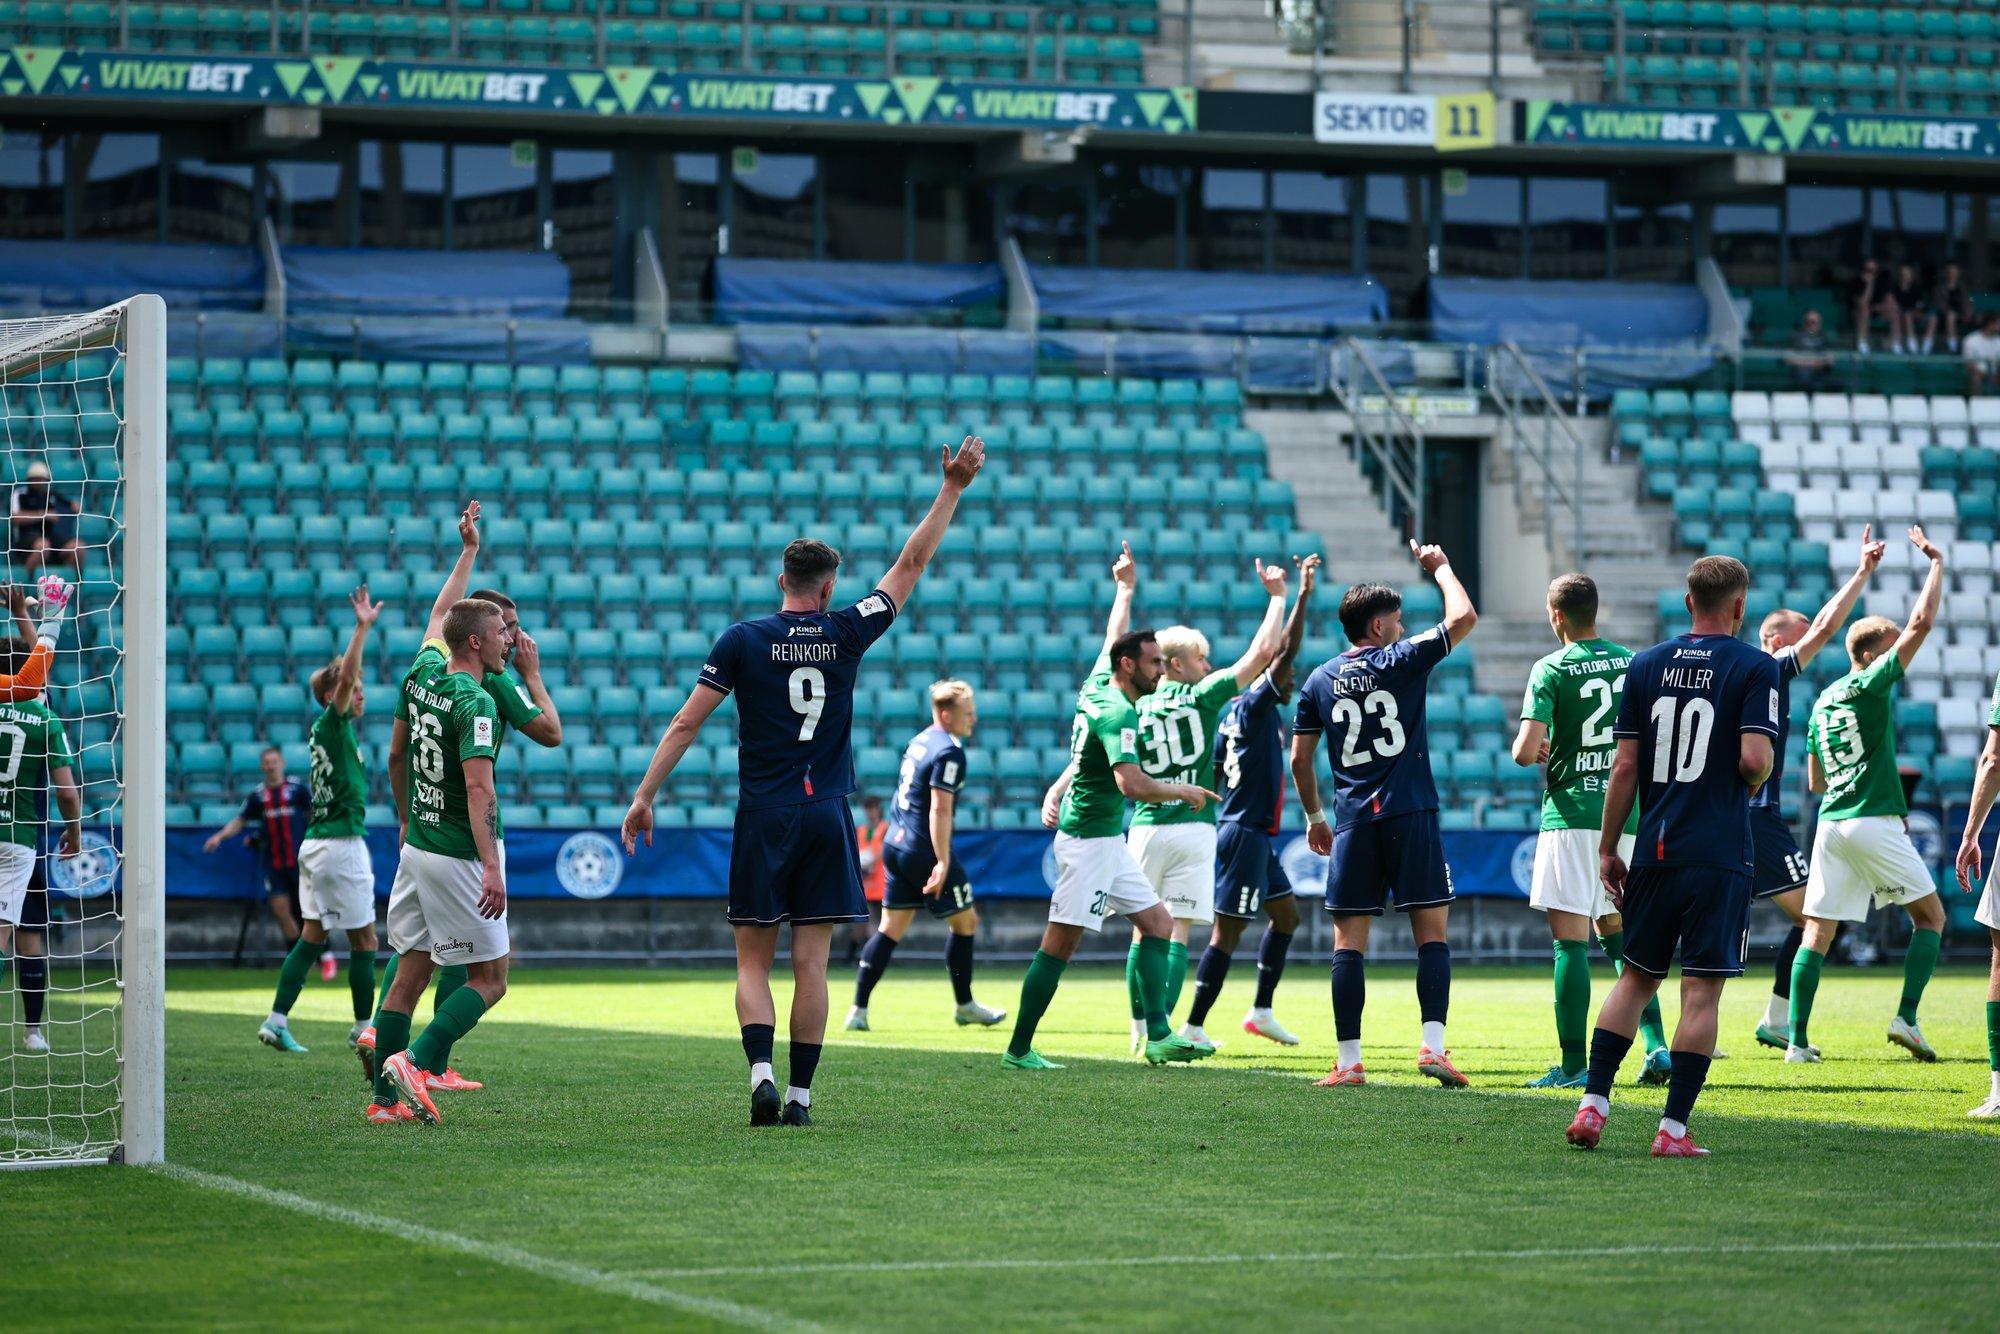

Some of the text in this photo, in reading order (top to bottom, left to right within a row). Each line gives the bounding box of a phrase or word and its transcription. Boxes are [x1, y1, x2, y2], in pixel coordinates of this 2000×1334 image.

[99, 60, 253, 93] VIVATBET
[397, 69, 548, 103] VIVATBET
[687, 80, 836, 112] VIVATBET
[971, 89, 1117, 122] VIVATBET
[1323, 103, 1481, 137] SEKTOR 11
[1581, 110, 1721, 143] VIVATBET
[1845, 118, 1980, 151] VIVATBET
[772, 643, 837, 662] REINKORT
[1568, 664, 1581, 676] FC
[1581, 660, 1611, 674] FLORA
[1683, 648, 1713, 657] KINDLE
[1661, 667, 1714, 690] MILLER
[788, 666, 827, 742] 9
[1138, 706, 1205, 775] 30
[1331, 689, 1406, 768] 23
[1650, 695, 1715, 784] 10
[1816, 708, 1865, 774] 13
[434, 939, 474, 954] Gausberg
